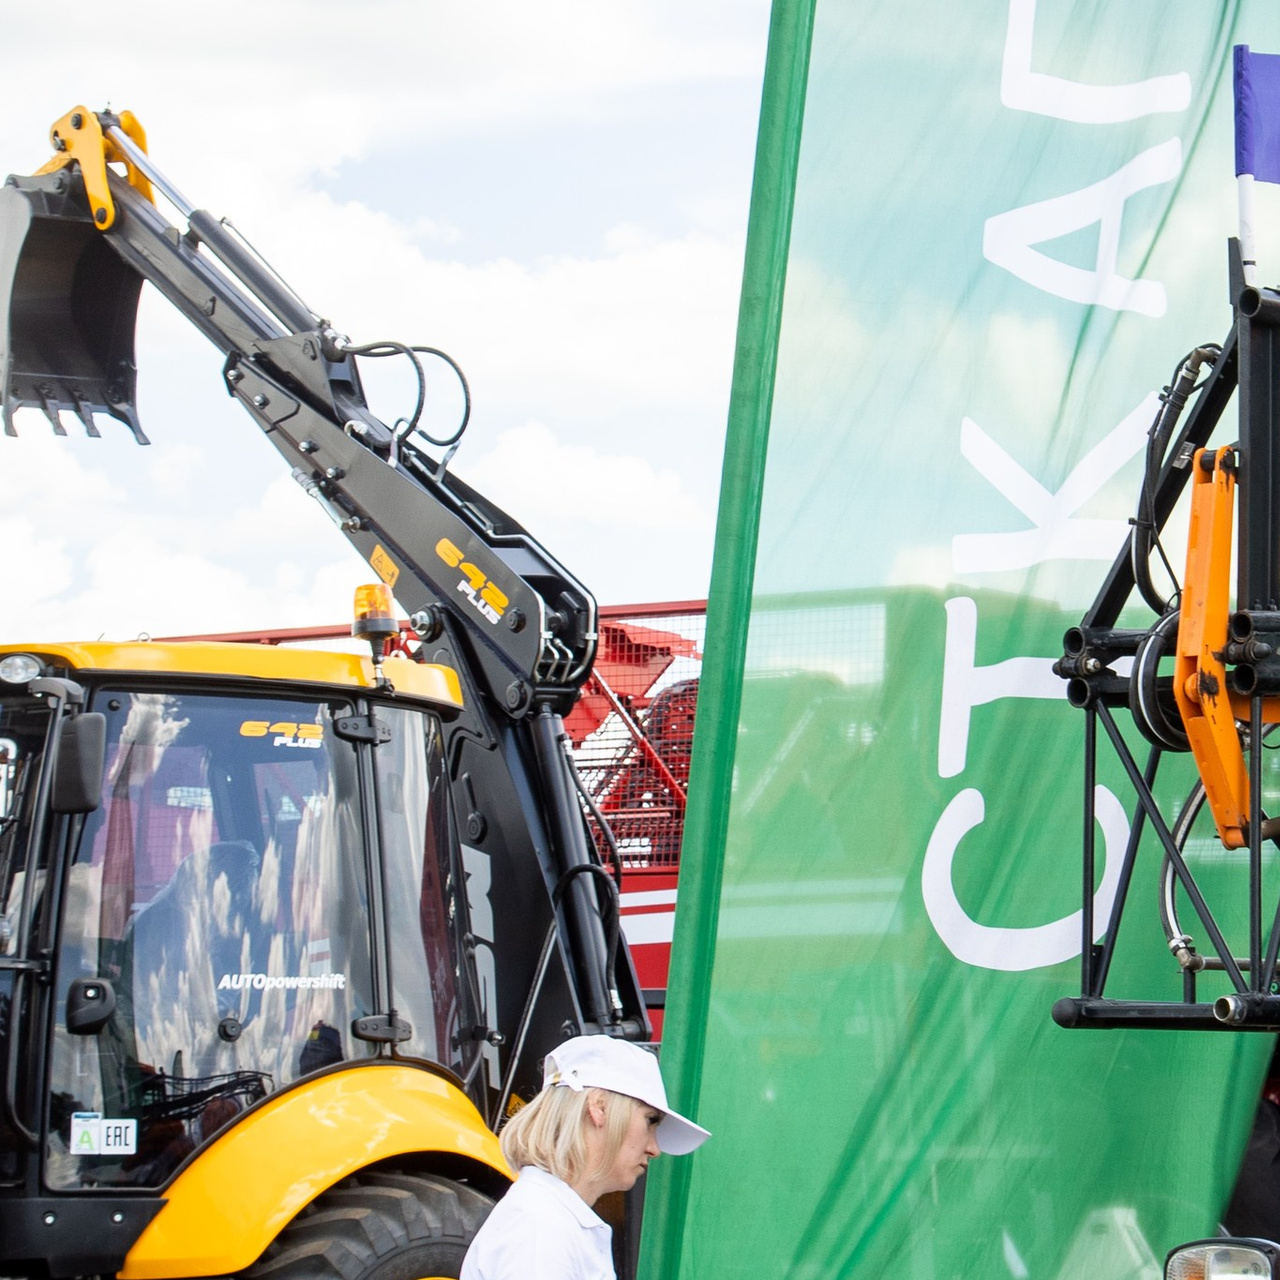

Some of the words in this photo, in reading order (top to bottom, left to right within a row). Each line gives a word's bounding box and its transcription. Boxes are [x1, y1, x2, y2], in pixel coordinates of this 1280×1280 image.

[435, 538, 509, 616] 642
[457, 580, 502, 625] PLUS
[240, 721, 323, 739] 642
[273, 736, 322, 749] PLUS
[218, 973, 346, 991] AUTOpowershift
[106, 1125, 130, 1147] EAC
